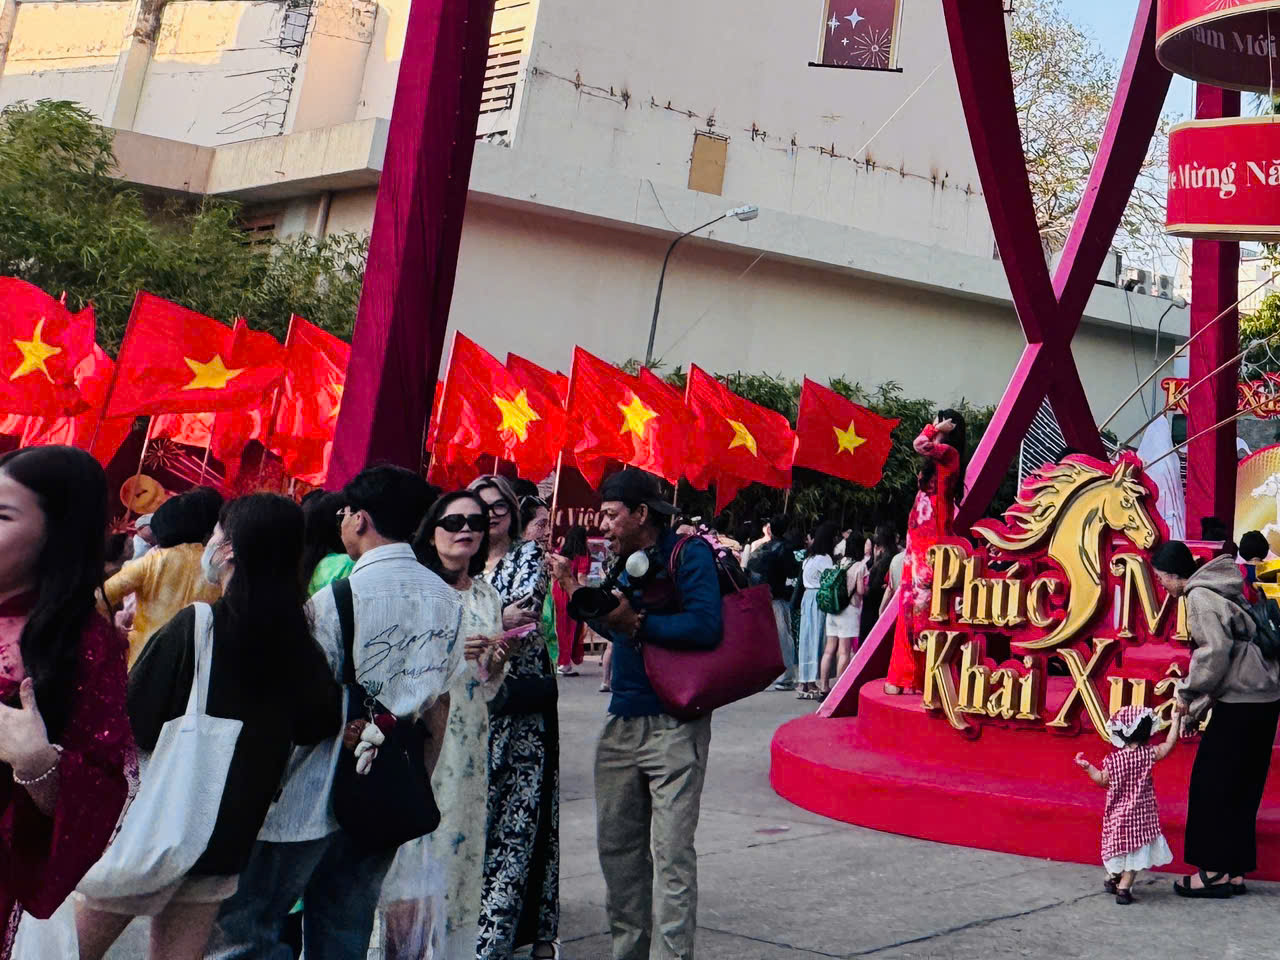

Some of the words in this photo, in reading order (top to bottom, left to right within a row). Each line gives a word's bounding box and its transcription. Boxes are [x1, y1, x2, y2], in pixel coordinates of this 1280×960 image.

[1232, 31, 1278, 58] Mới
[1179, 161, 1237, 199] Mừng
[927, 544, 1056, 628] Phúc
[915, 630, 1042, 730] Khai
[1046, 638, 1213, 744] Xuâ
